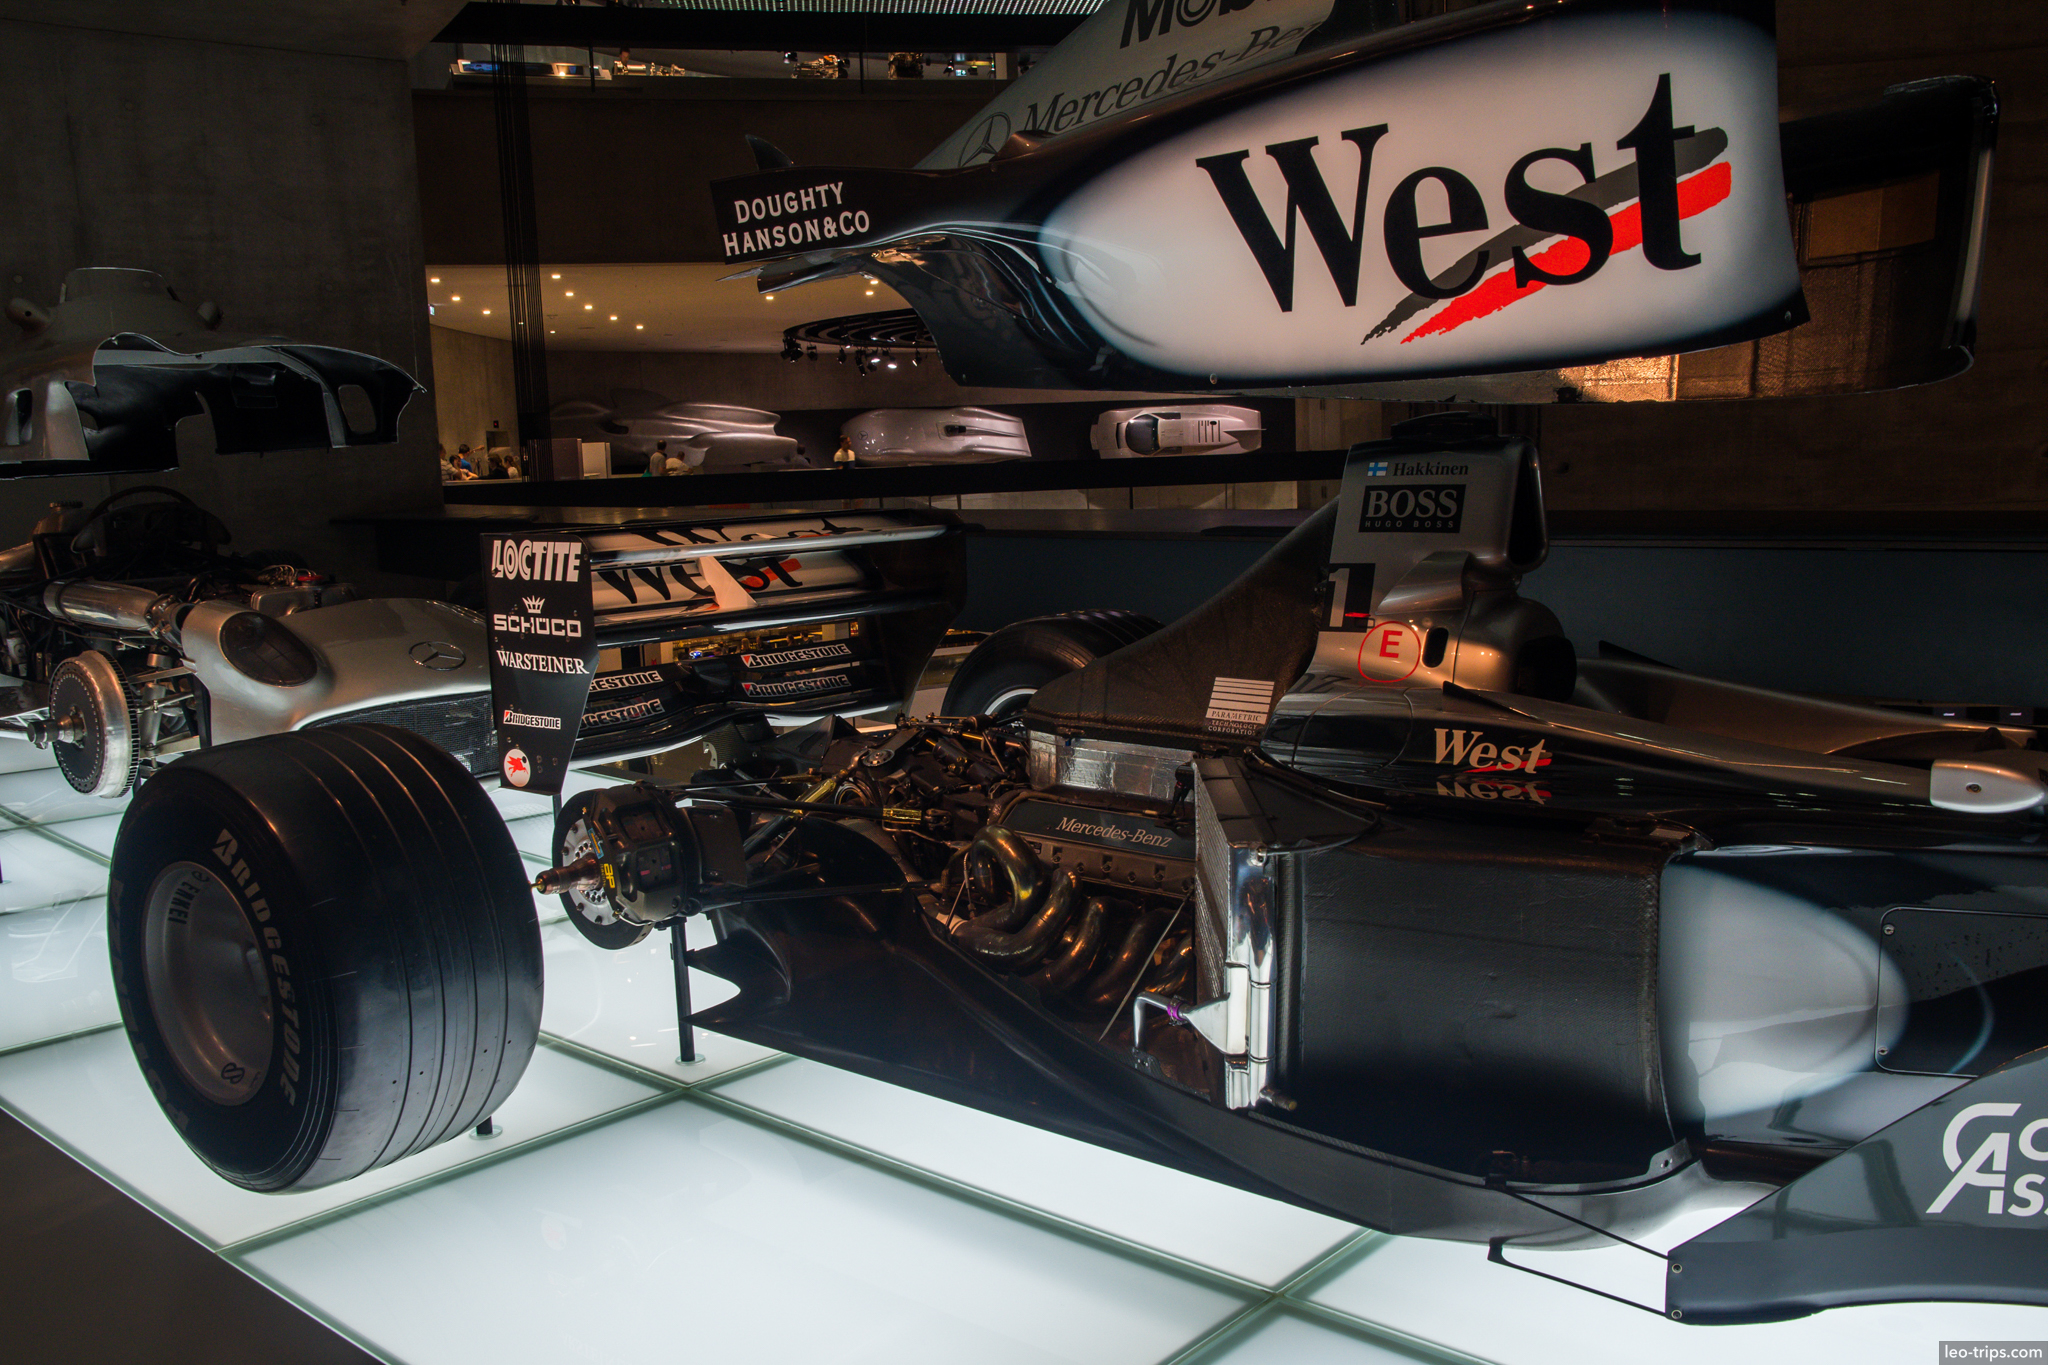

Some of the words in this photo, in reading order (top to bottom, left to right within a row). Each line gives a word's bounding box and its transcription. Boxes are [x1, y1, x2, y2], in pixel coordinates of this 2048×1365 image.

[734, 181, 843, 224] DOUGHTY
[1195, 73, 1703, 313] West
[722, 210, 870, 257] HANSON&CO
[1393, 462, 1469, 477] Hakkinen
[1366, 489, 1458, 518] BOSS
[1365, 520, 1403, 529] HUGO
[1413, 520, 1454, 529] BOSS
[491, 539, 582, 583] LOCTITE
[1328, 568, 1350, 628] 1
[493, 613, 582, 638] SCHÜCO
[741, 643, 852, 669] BRIDGESTONE
[1379, 630, 1403, 659] E
[496, 650, 590, 674] WARSTEINER
[741, 674, 852, 698] BRIDGESTONE
[503, 710, 561, 730] BRIDGESTONE
[1211, 710, 1262, 722] PARAMETRIC
[1434, 728, 1547, 775] West
[1055, 817, 1173, 849] Mercedes-Benz
[168, 881, 201, 925] ENKEI
[212, 828, 301, 1107] BRIDGESTONE
